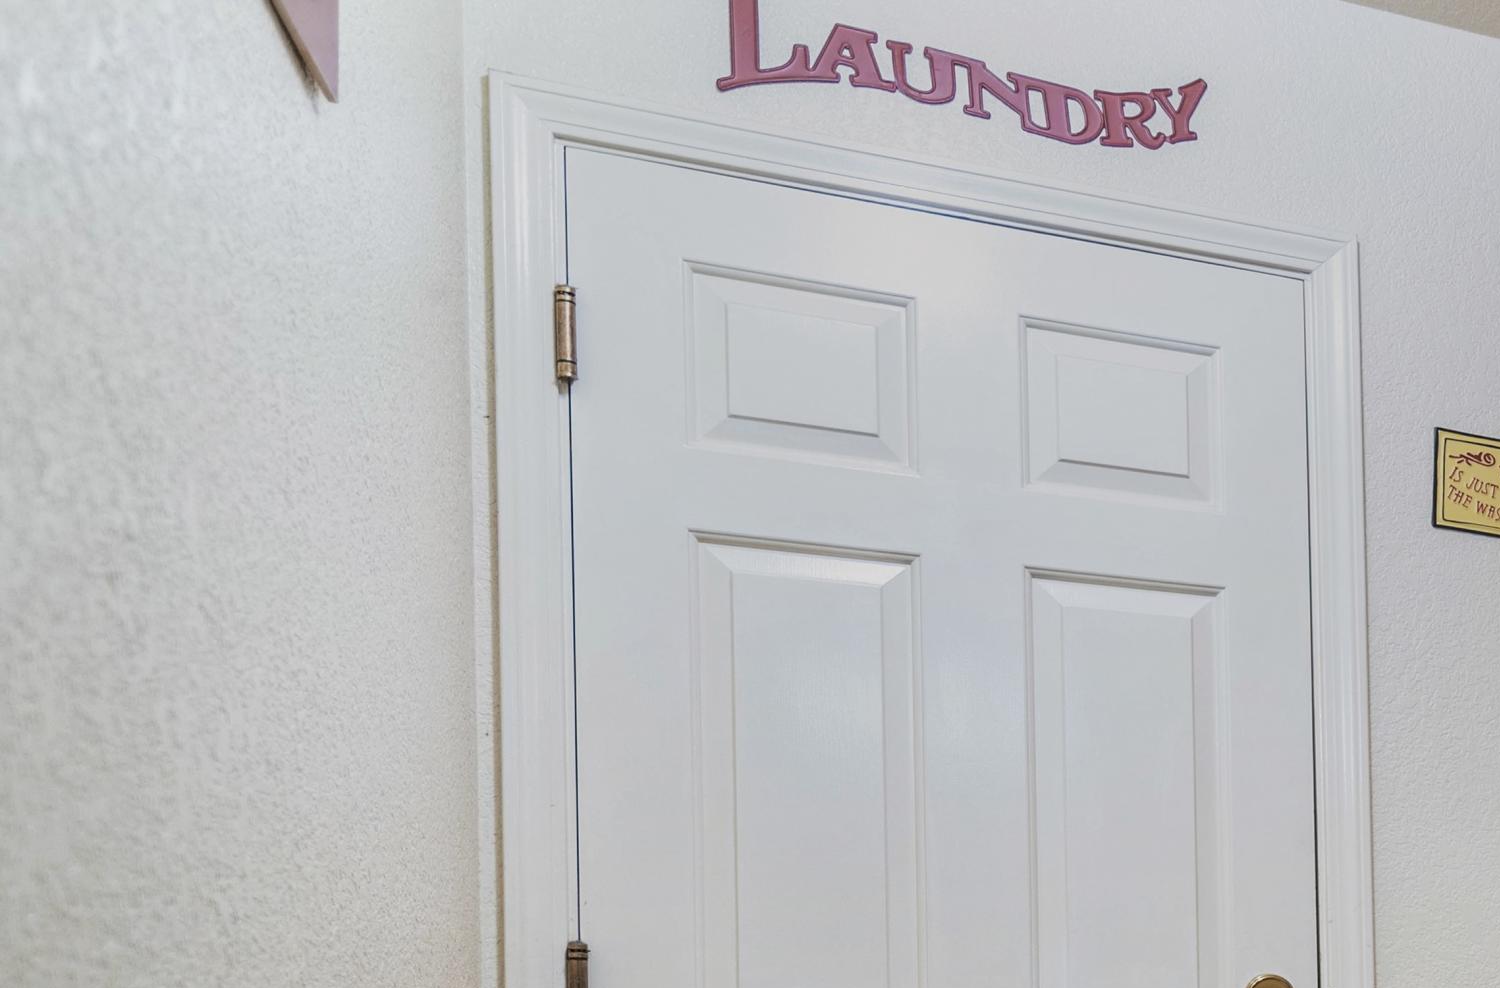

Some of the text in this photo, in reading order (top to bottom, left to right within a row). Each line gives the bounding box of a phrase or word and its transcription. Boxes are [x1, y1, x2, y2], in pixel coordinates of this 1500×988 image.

[716, 0, 1207, 149] LAUNDRY
[1447, 484, 1473, 509] THE
[1449, 466, 1464, 483] IS
[1466, 477, 1499, 499] JUST
